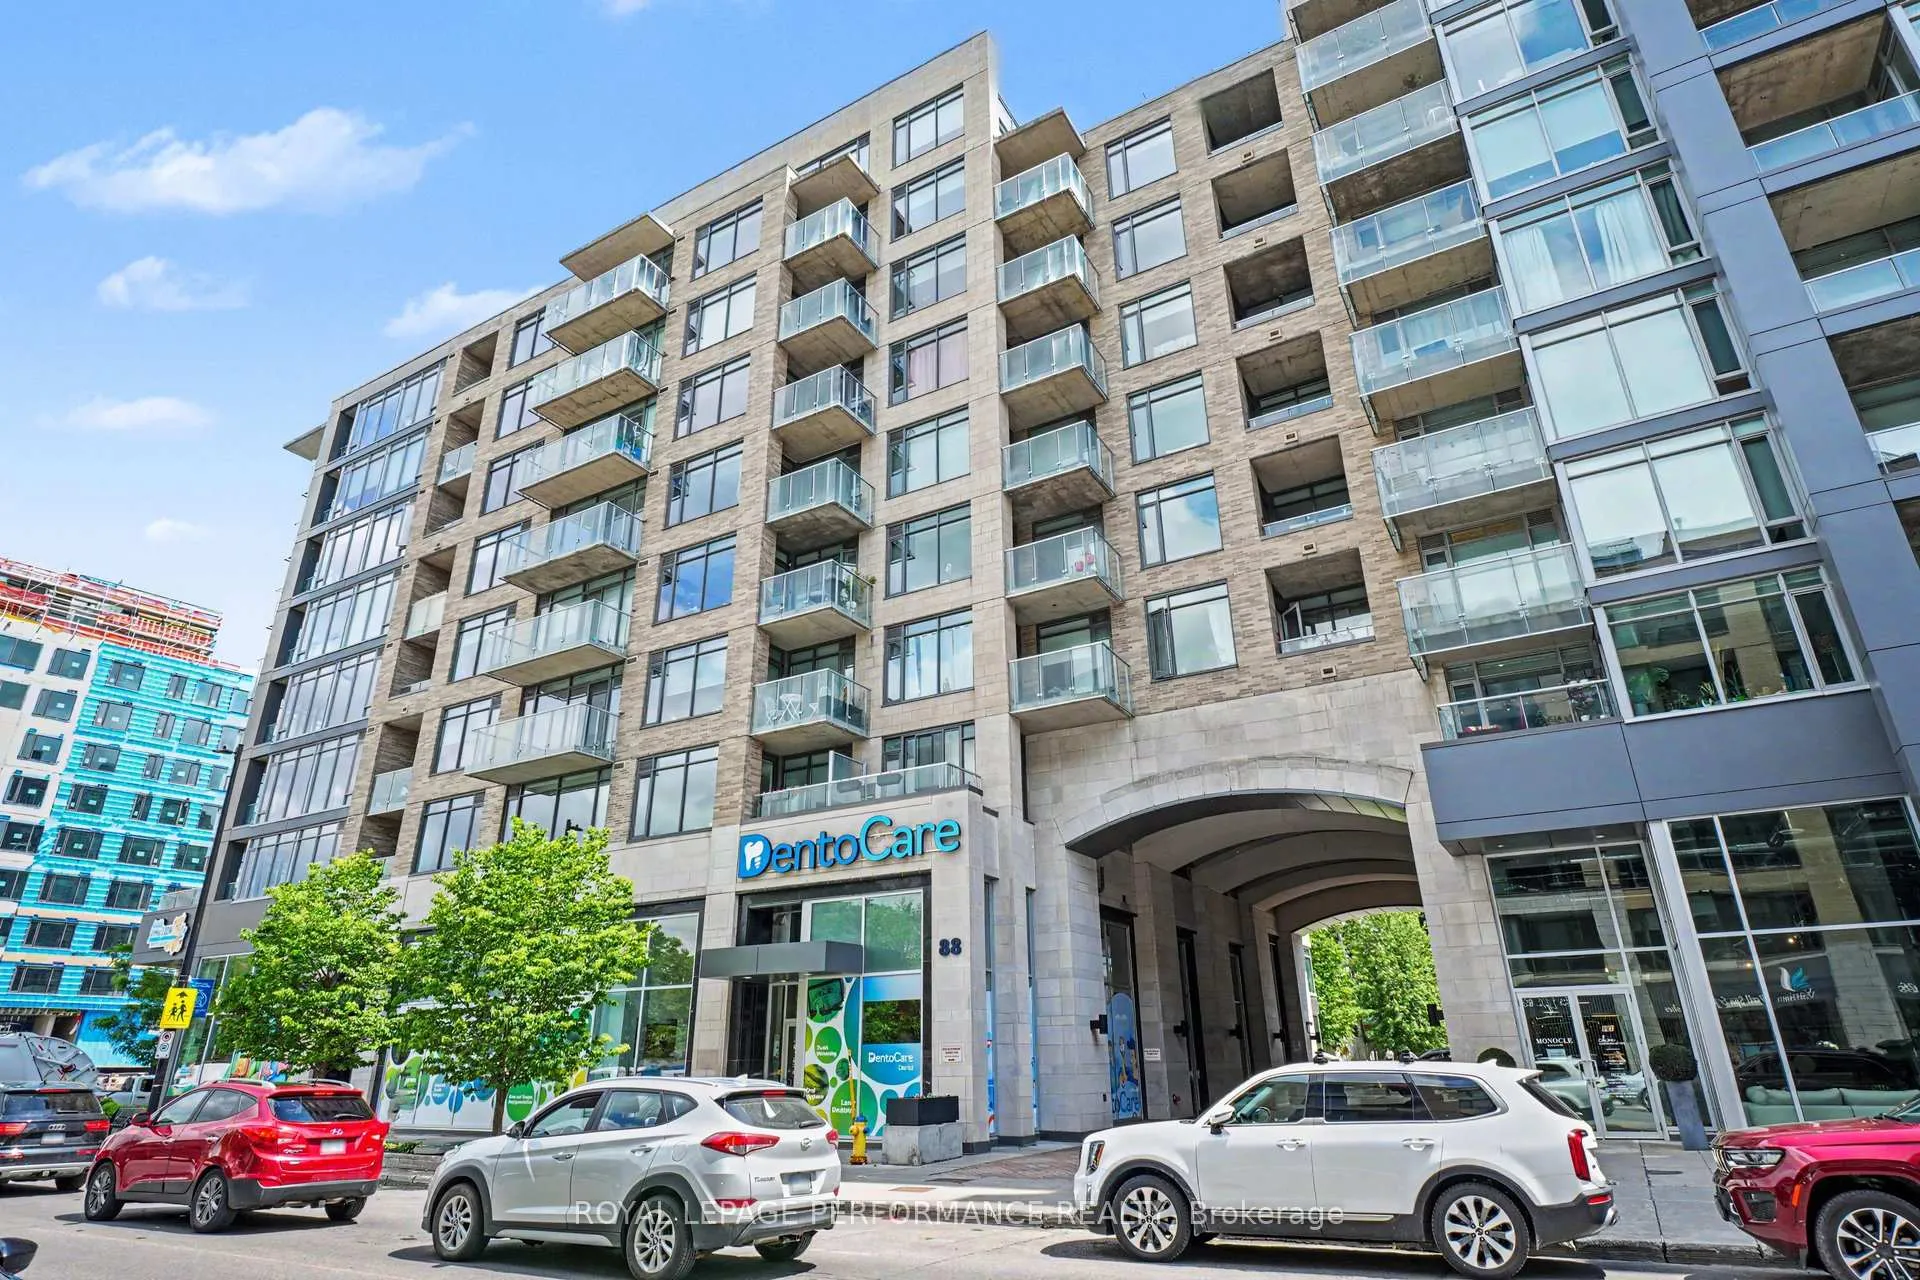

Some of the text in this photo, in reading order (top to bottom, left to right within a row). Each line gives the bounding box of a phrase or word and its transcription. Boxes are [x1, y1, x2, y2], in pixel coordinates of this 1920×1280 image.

[738, 815, 961, 879] DentoCare
[939, 938, 962, 956] 88
[868, 1051, 914, 1063] DentoCare
